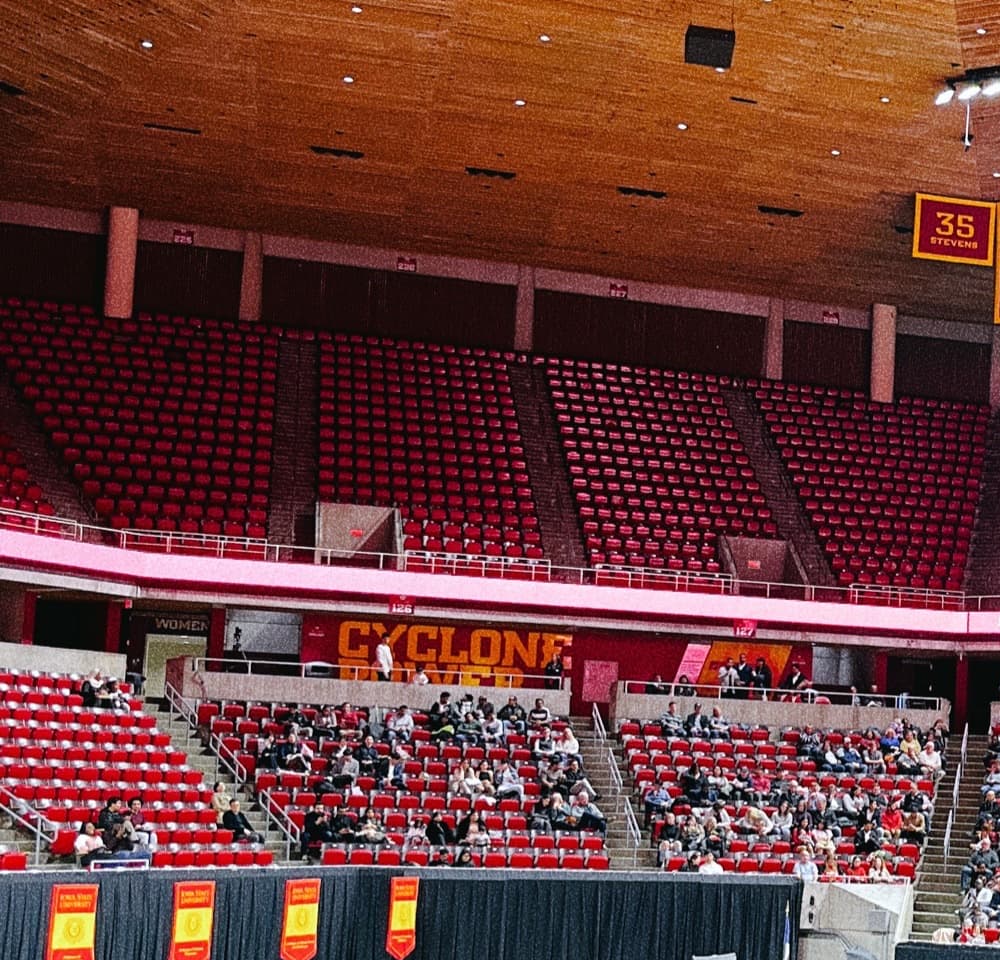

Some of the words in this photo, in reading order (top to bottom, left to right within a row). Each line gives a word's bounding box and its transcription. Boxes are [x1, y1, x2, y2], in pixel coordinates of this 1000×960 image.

[936, 212, 974, 238] 35
[930, 236, 978, 249] STEVENS
[392, 603, 412, 614] 126
[155, 618, 209, 631] WOMEN
[735, 626, 753, 637] 127
[338, 620, 573, 669] CYCLONE
